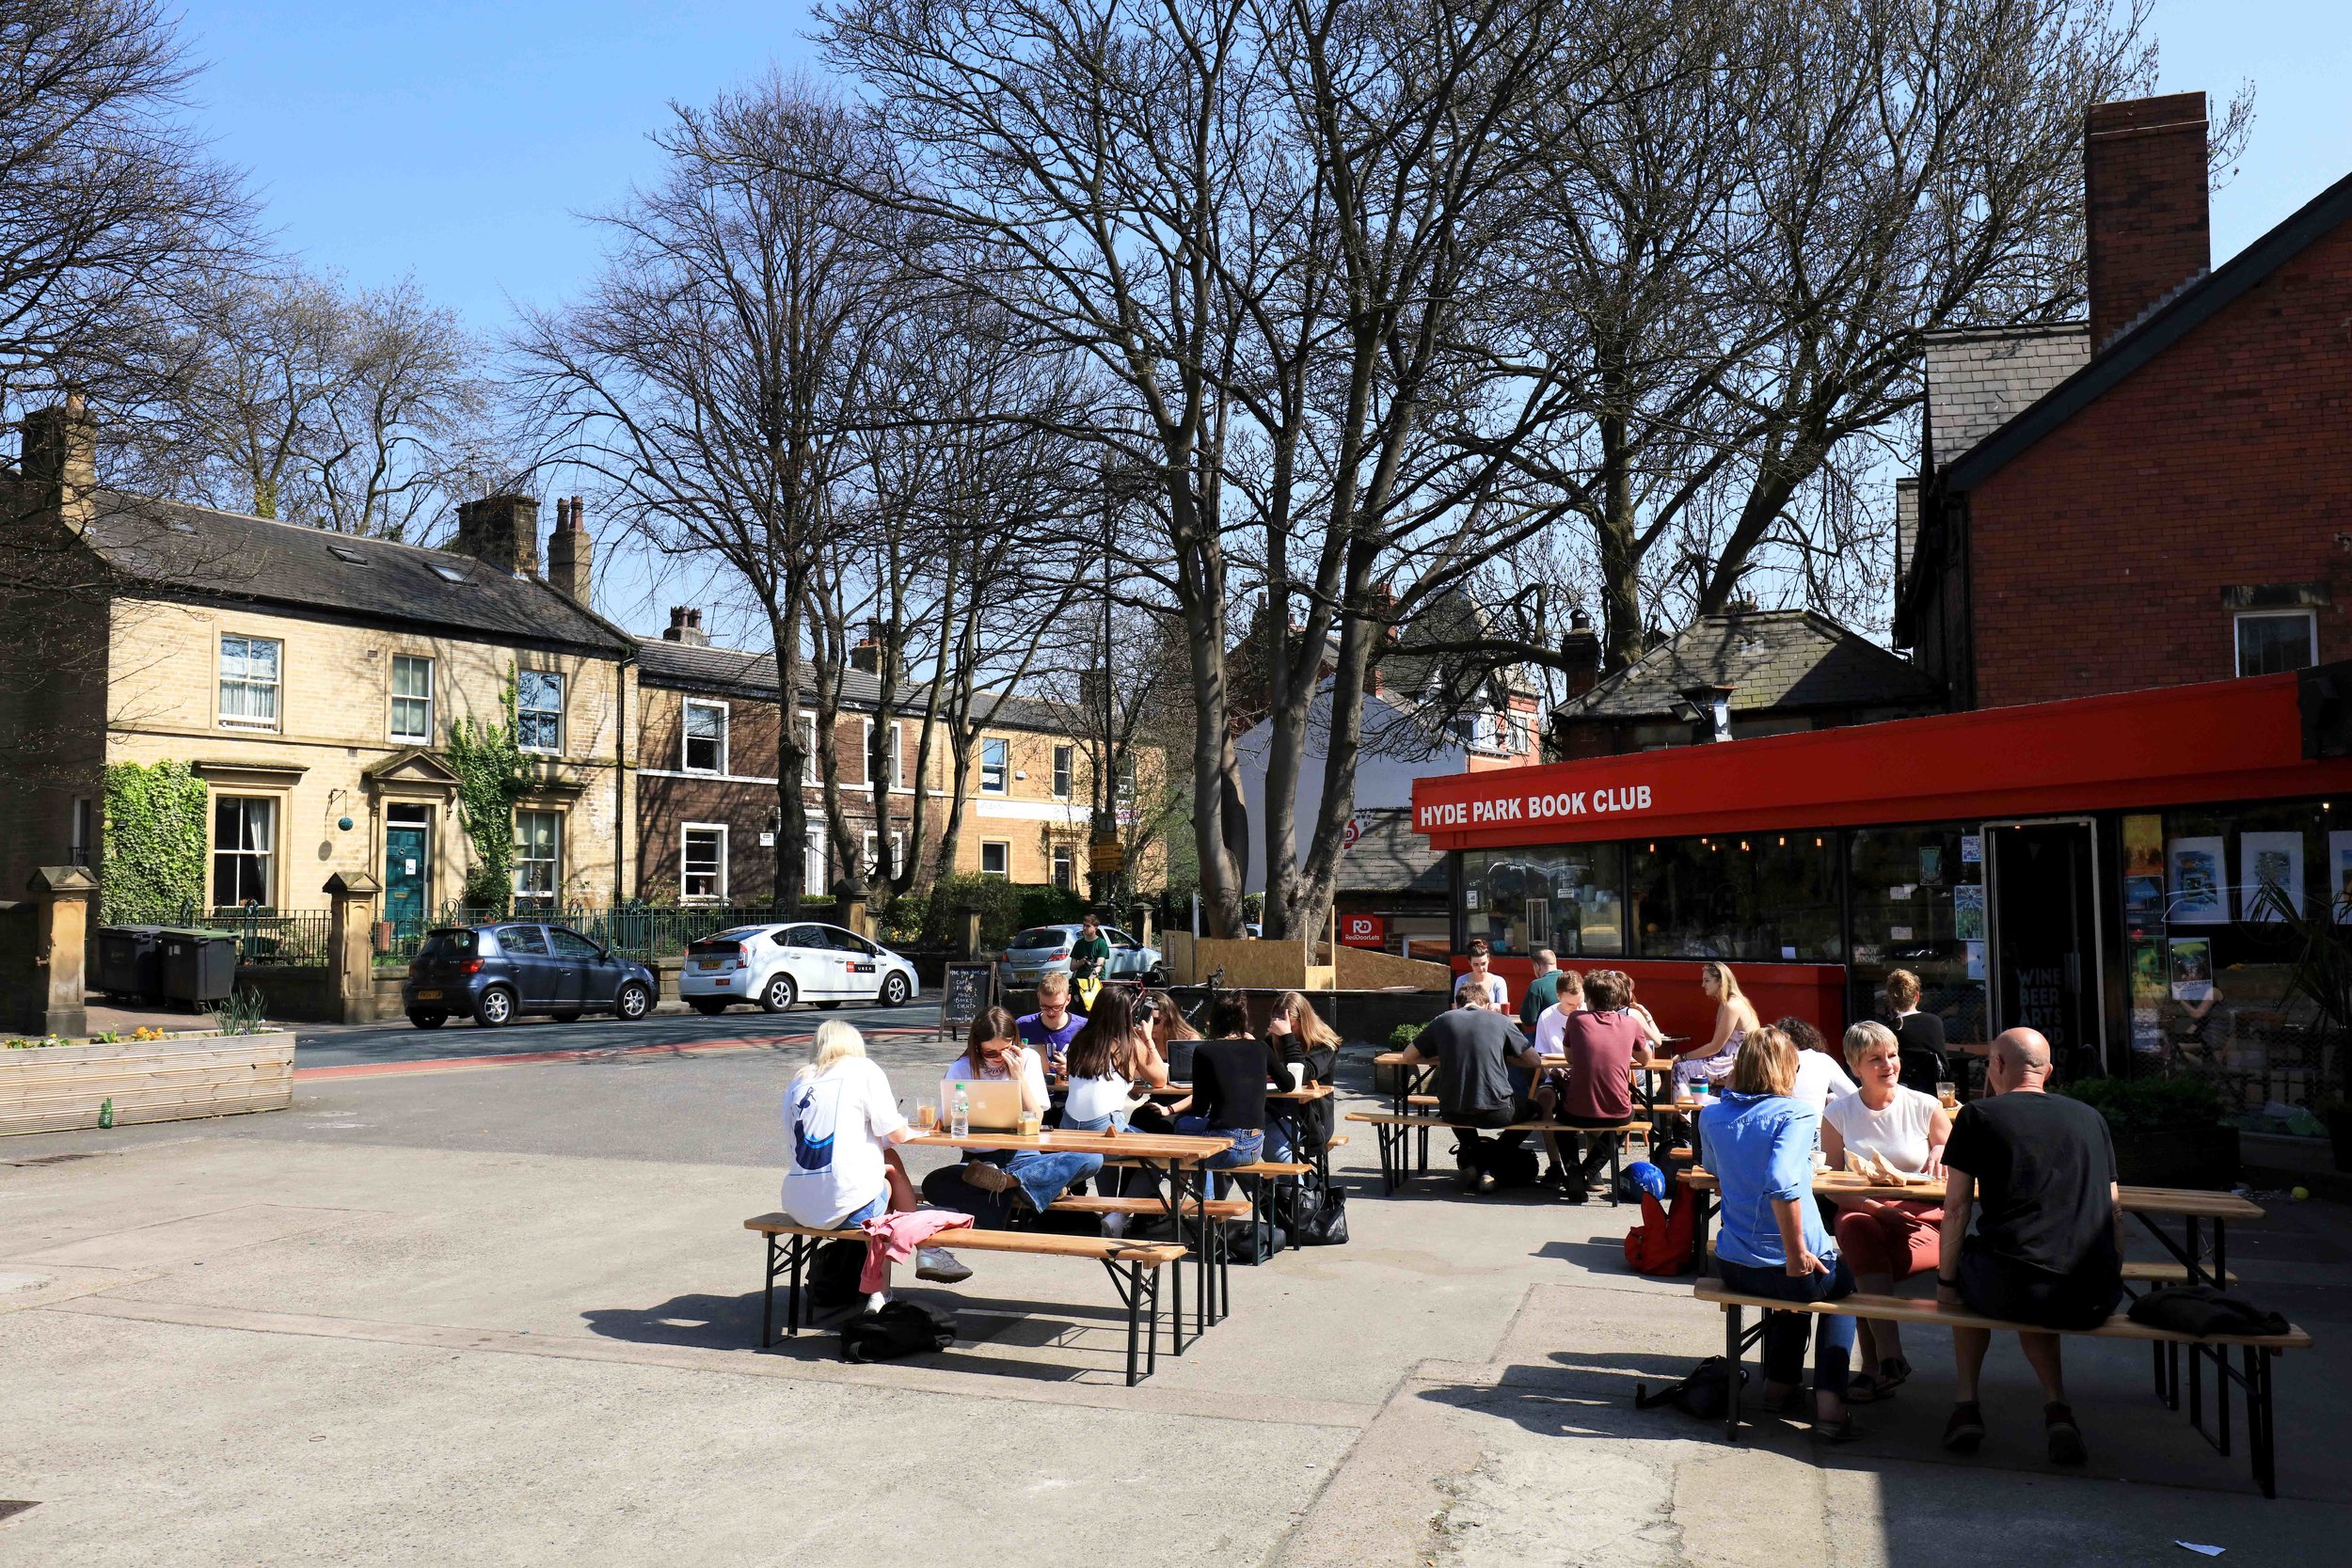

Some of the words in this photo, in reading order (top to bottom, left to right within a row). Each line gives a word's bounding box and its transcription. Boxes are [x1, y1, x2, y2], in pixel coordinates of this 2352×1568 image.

[1421, 802, 1468, 827] HYDE
[1473, 798, 1522, 822] PARK
[1529, 791, 1586, 818] BOOK
[1593, 785, 1652, 813] CLUB
[1353, 920, 1372, 934] RD
[2016, 968, 2061, 986] WINE
[2019, 987, 2059, 1006] BEER
[2019, 1006, 2062, 1025] ARTS
